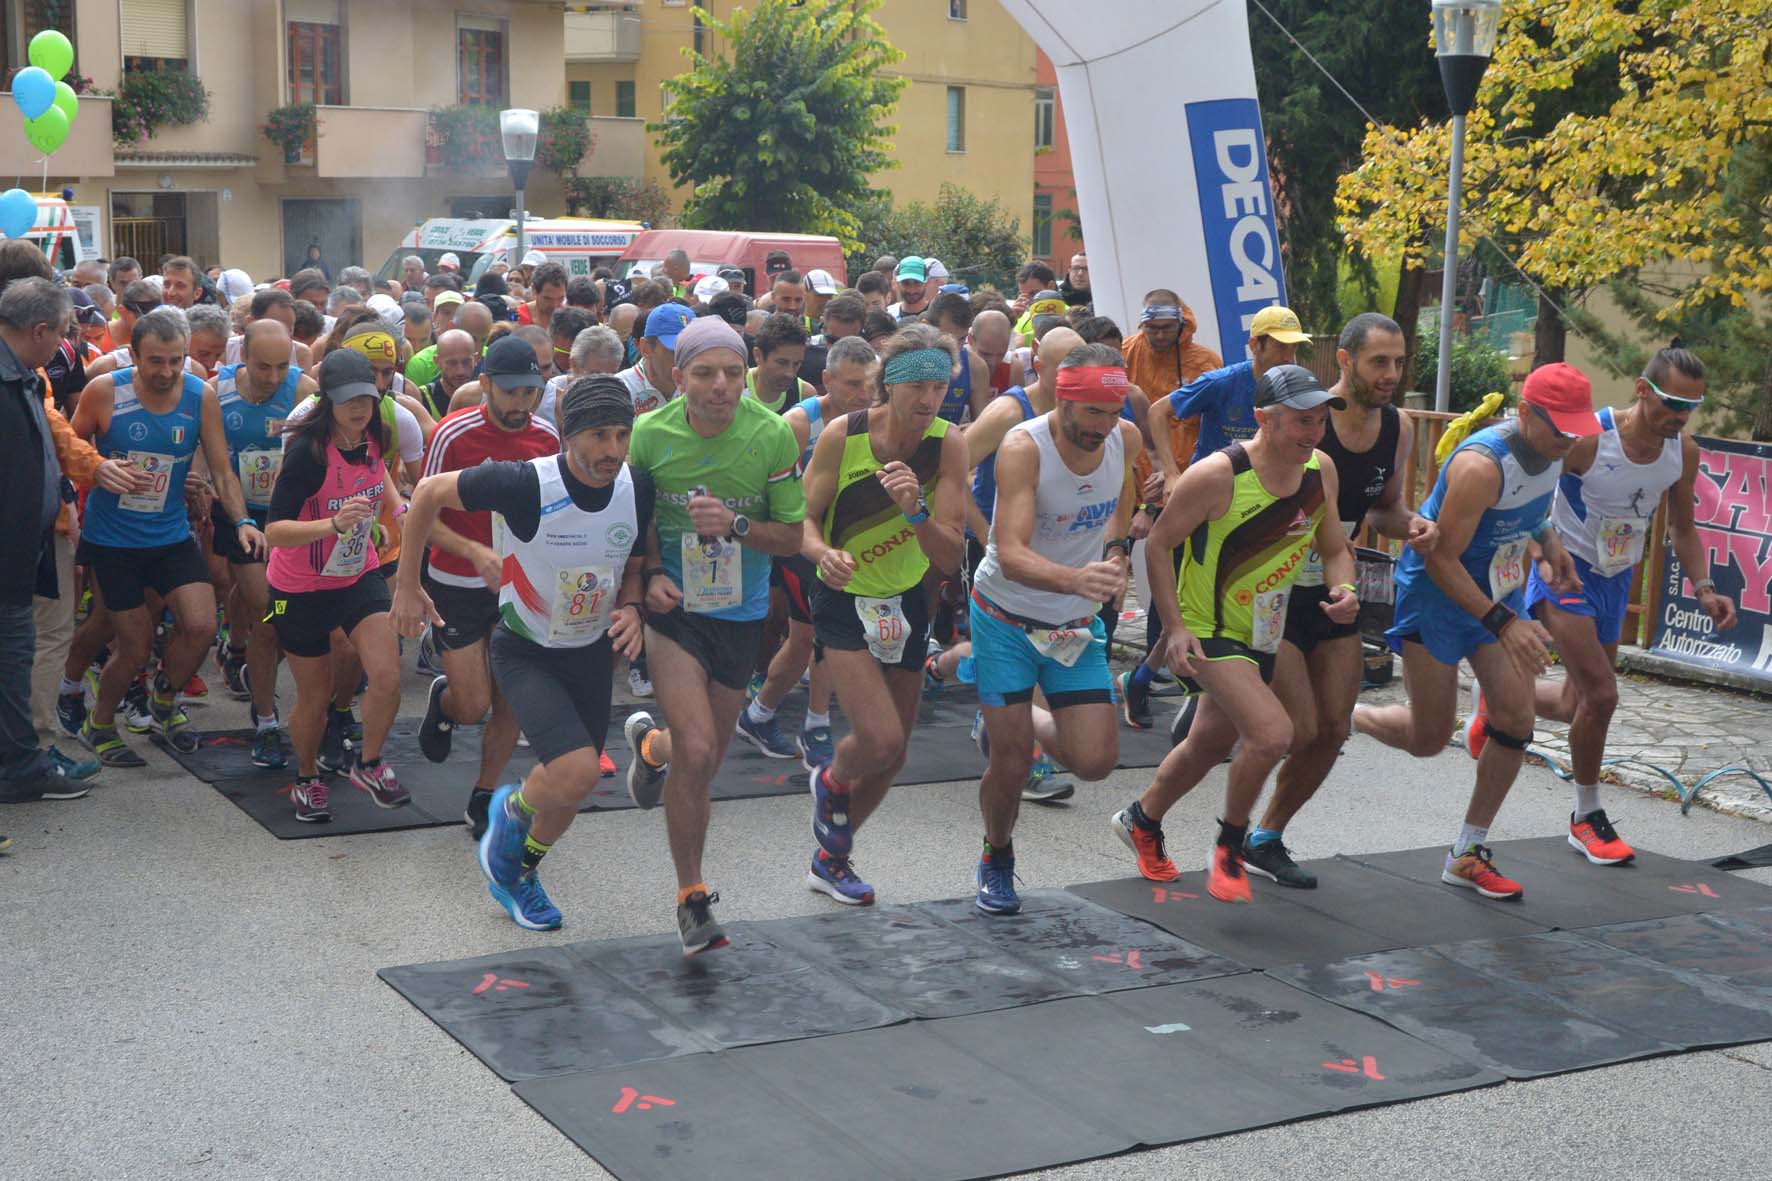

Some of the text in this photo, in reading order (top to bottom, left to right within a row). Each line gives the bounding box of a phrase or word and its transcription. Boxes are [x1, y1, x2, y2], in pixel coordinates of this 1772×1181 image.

[531, 234, 626, 246] UNITA' MOBILE DI SOCCORSO
[1212, 128, 1280, 360] DECA
[570, 259, 588, 275] VERDE
[343, 535, 365, 558] 36
[709, 560, 718, 584] 1
[568, 592, 602, 616] 81
[878, 617, 904, 642] 60
[1664, 602, 1713, 634] Centro
[1659, 628, 1742, 664] Autorizzato
